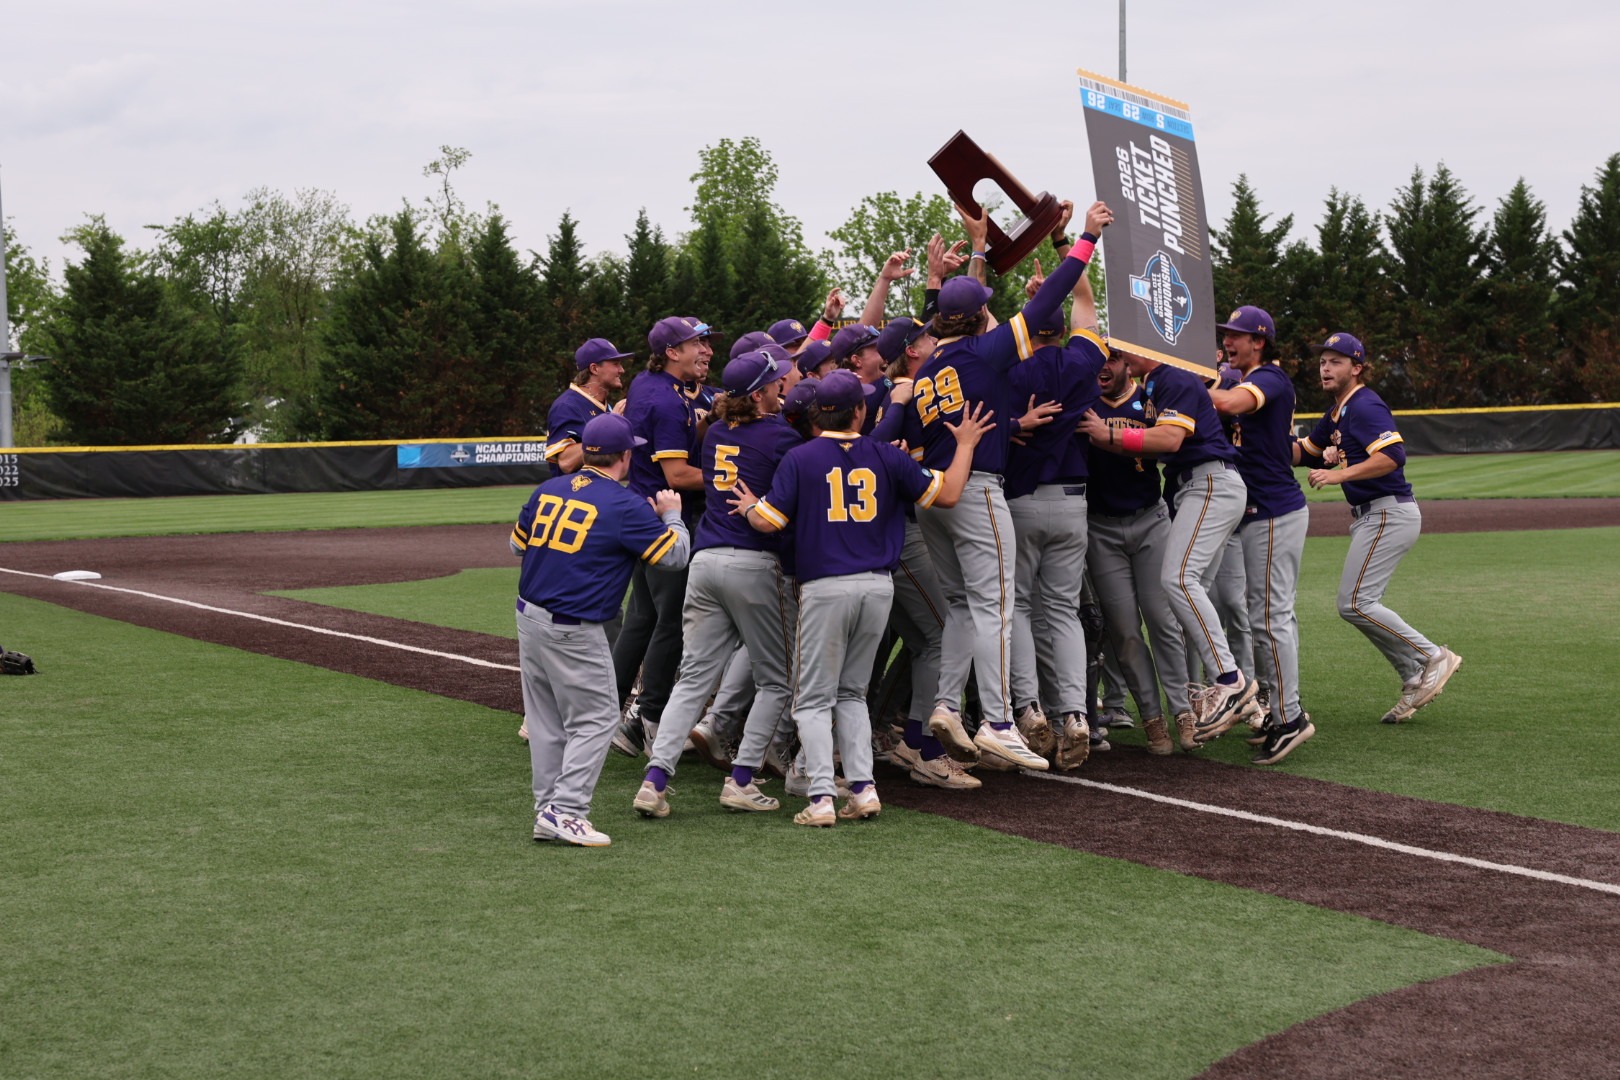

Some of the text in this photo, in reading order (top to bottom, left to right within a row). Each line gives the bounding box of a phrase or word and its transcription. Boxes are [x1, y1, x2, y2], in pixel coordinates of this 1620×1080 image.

[1087, 91, 1106, 110] 26
[1122, 102, 1140, 121] 29
[1156, 113, 1165, 129] S
[1115, 146, 1136, 202] 2026
[1129, 140, 1161, 229] TICKET
[1149, 134, 1185, 255] PUNCHED
[1156, 272, 1164, 318] BASEBALL
[1160, 254, 1175, 342] CHAMPIONSHIP
[913, 365, 965, 428] 29
[475, 443, 503, 454] NCAA
[504, 443, 522, 453] DII
[712, 444, 741, 492] 5
[826, 466, 878, 523] 13
[528, 493, 599, 554] 88
